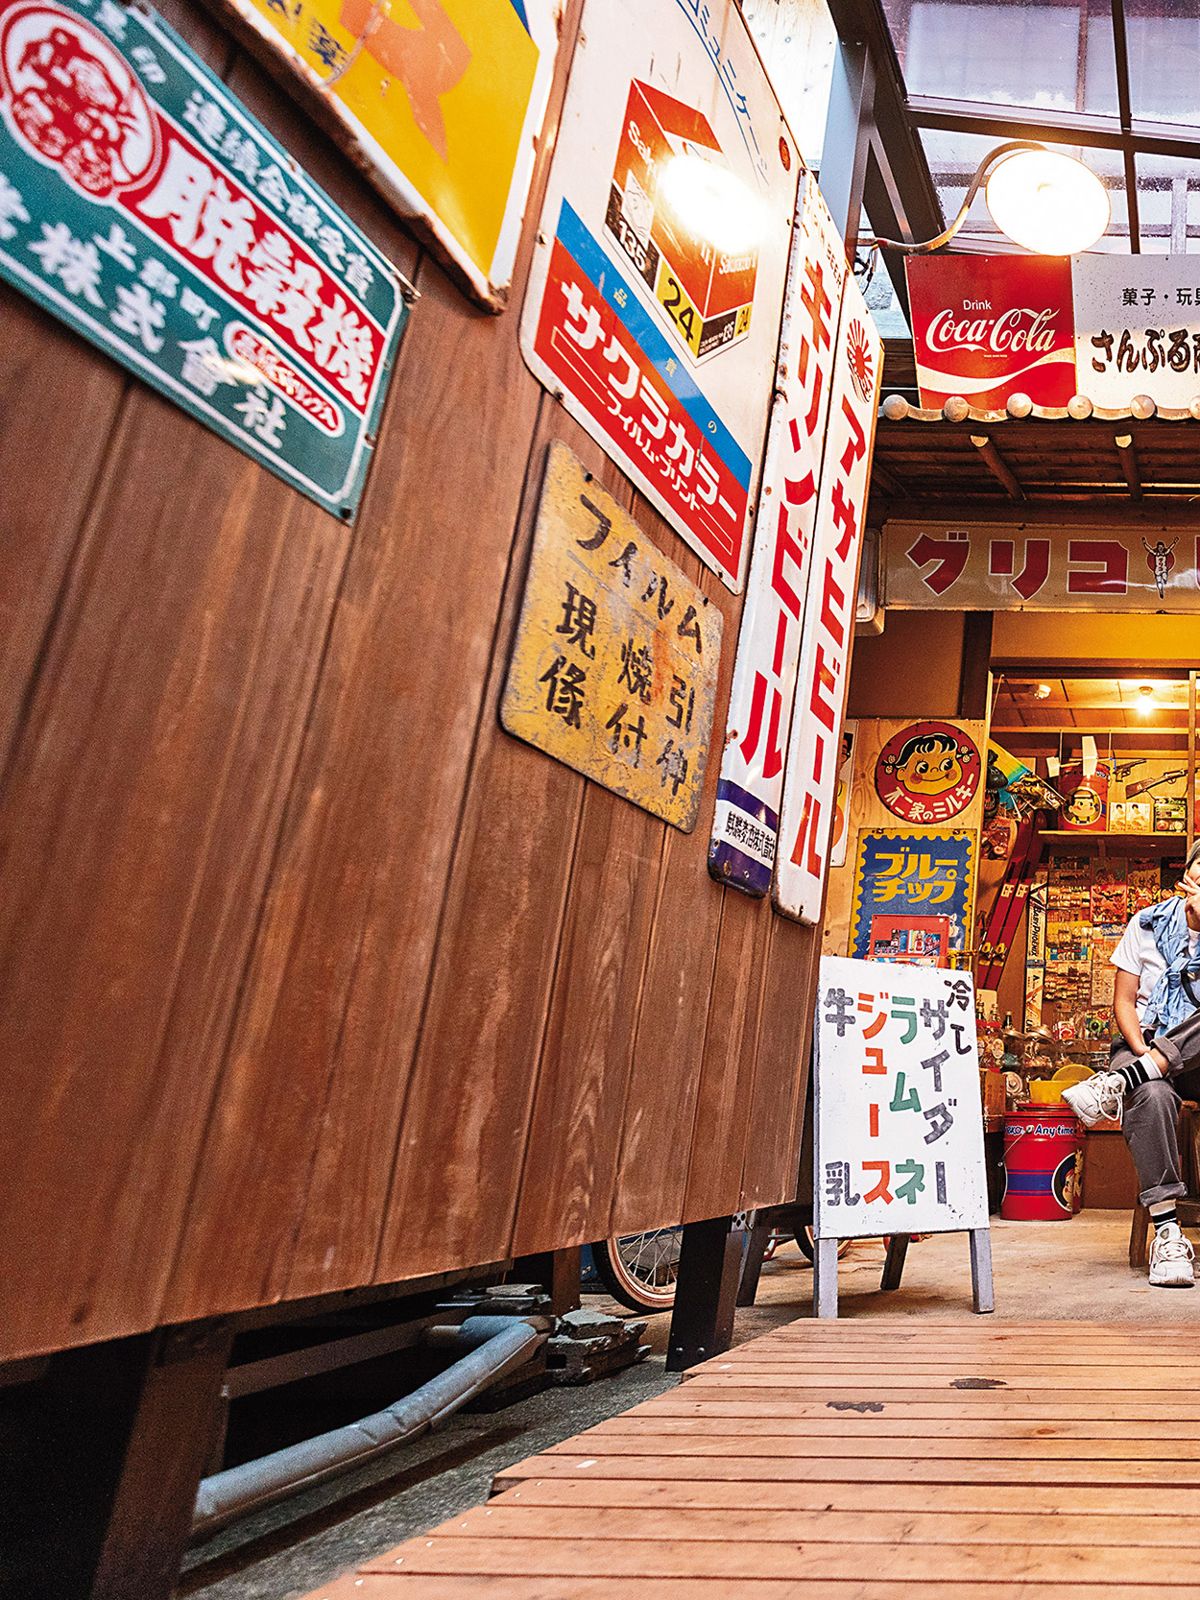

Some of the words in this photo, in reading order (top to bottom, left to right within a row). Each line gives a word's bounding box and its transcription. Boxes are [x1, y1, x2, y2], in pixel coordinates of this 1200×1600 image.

[617, 218, 648, 273] 135
[661, 277, 695, 344] 24
[925, 307, 1061, 353] Coca-Cola
[963, 299, 992, 311] Drink
[560, 281, 738, 523] サクラカラー
[740, 256, 832, 779] キリンビール
[904, 530, 1130, 602] グリコ
[789, 393, 867, 879] アサヒビール
[884, 772, 976, 822] 不二家のミルキー
[873, 846, 959, 881] ブルー
[873, 869, 957, 904] チップ
[943, 979, 973, 1056] 冷し
[823, 988, 861, 1207] 牛乳
[857, 991, 894, 1205] ジュース
[889, 995, 926, 1205] ラムネ
[919, 997, 958, 1205] サイダー
